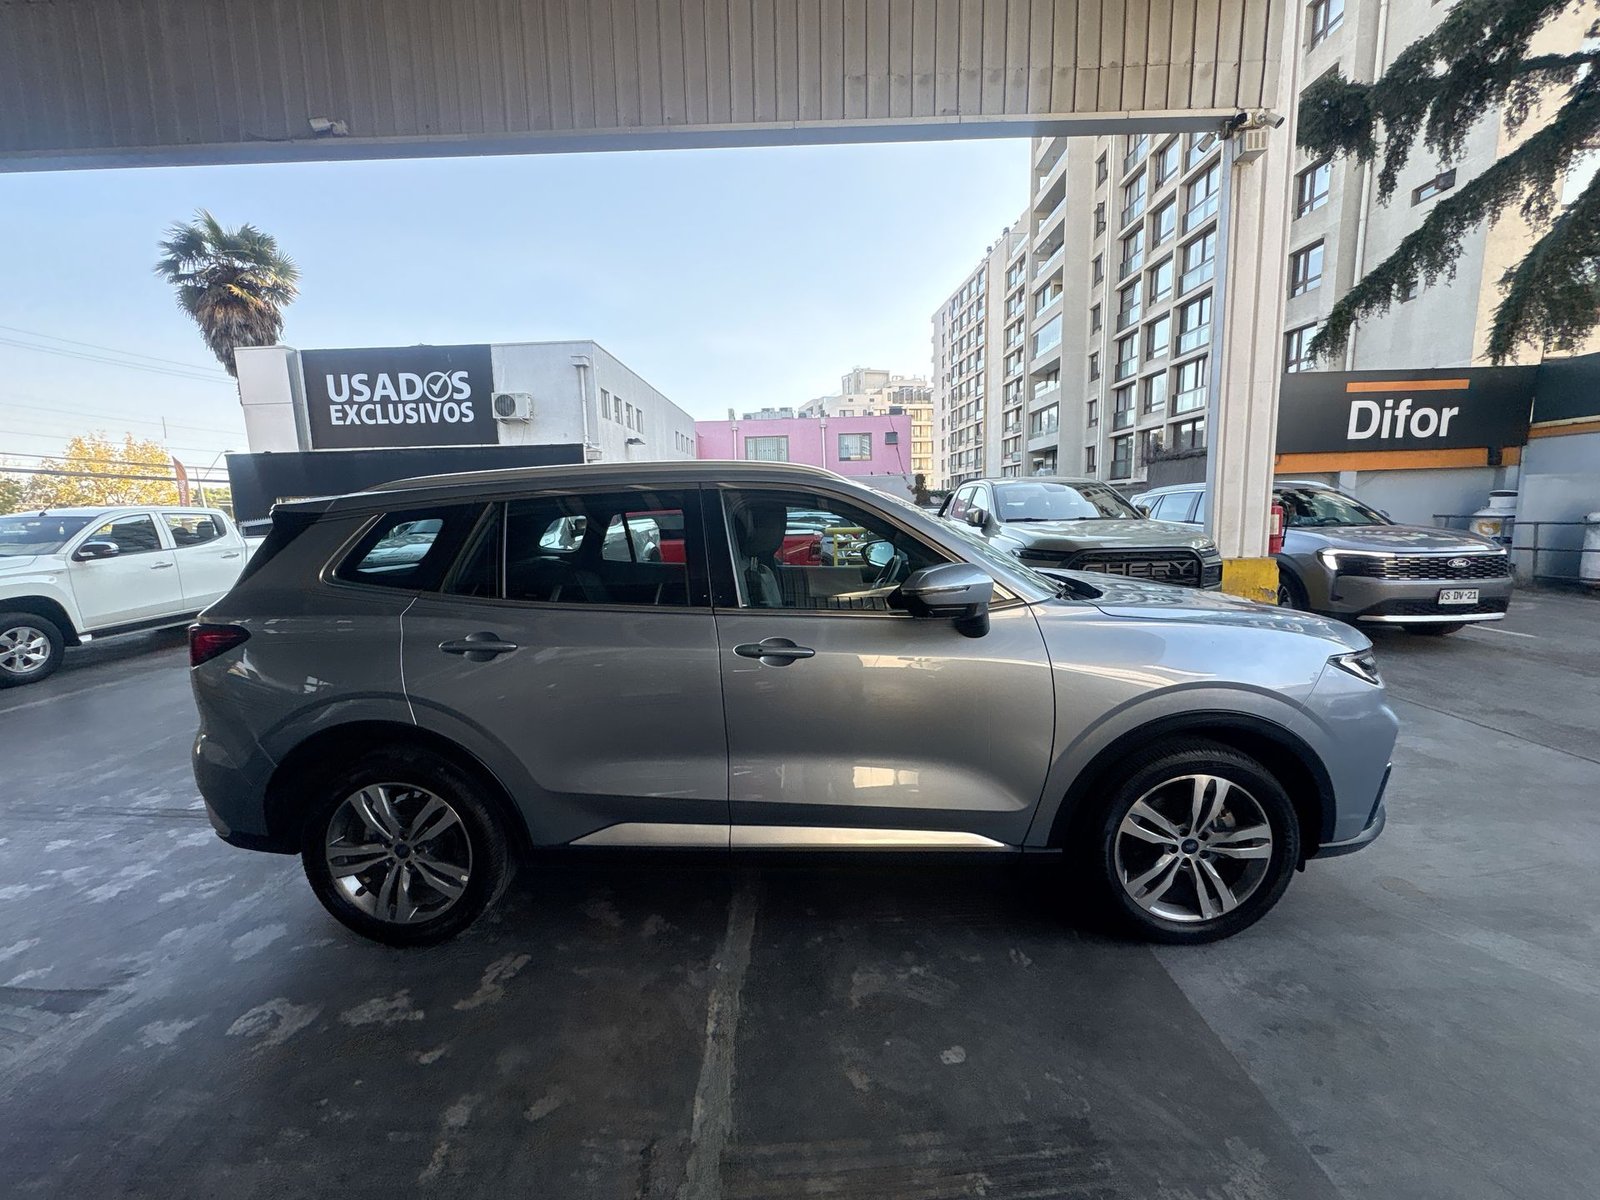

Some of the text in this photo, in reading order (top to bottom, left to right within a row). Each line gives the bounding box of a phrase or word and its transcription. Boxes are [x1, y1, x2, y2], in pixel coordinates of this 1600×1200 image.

[326, 370, 472, 402] USADOS
[329, 401, 475, 426] EXCLUSIVOS
[1347, 398, 1460, 440] Difor
